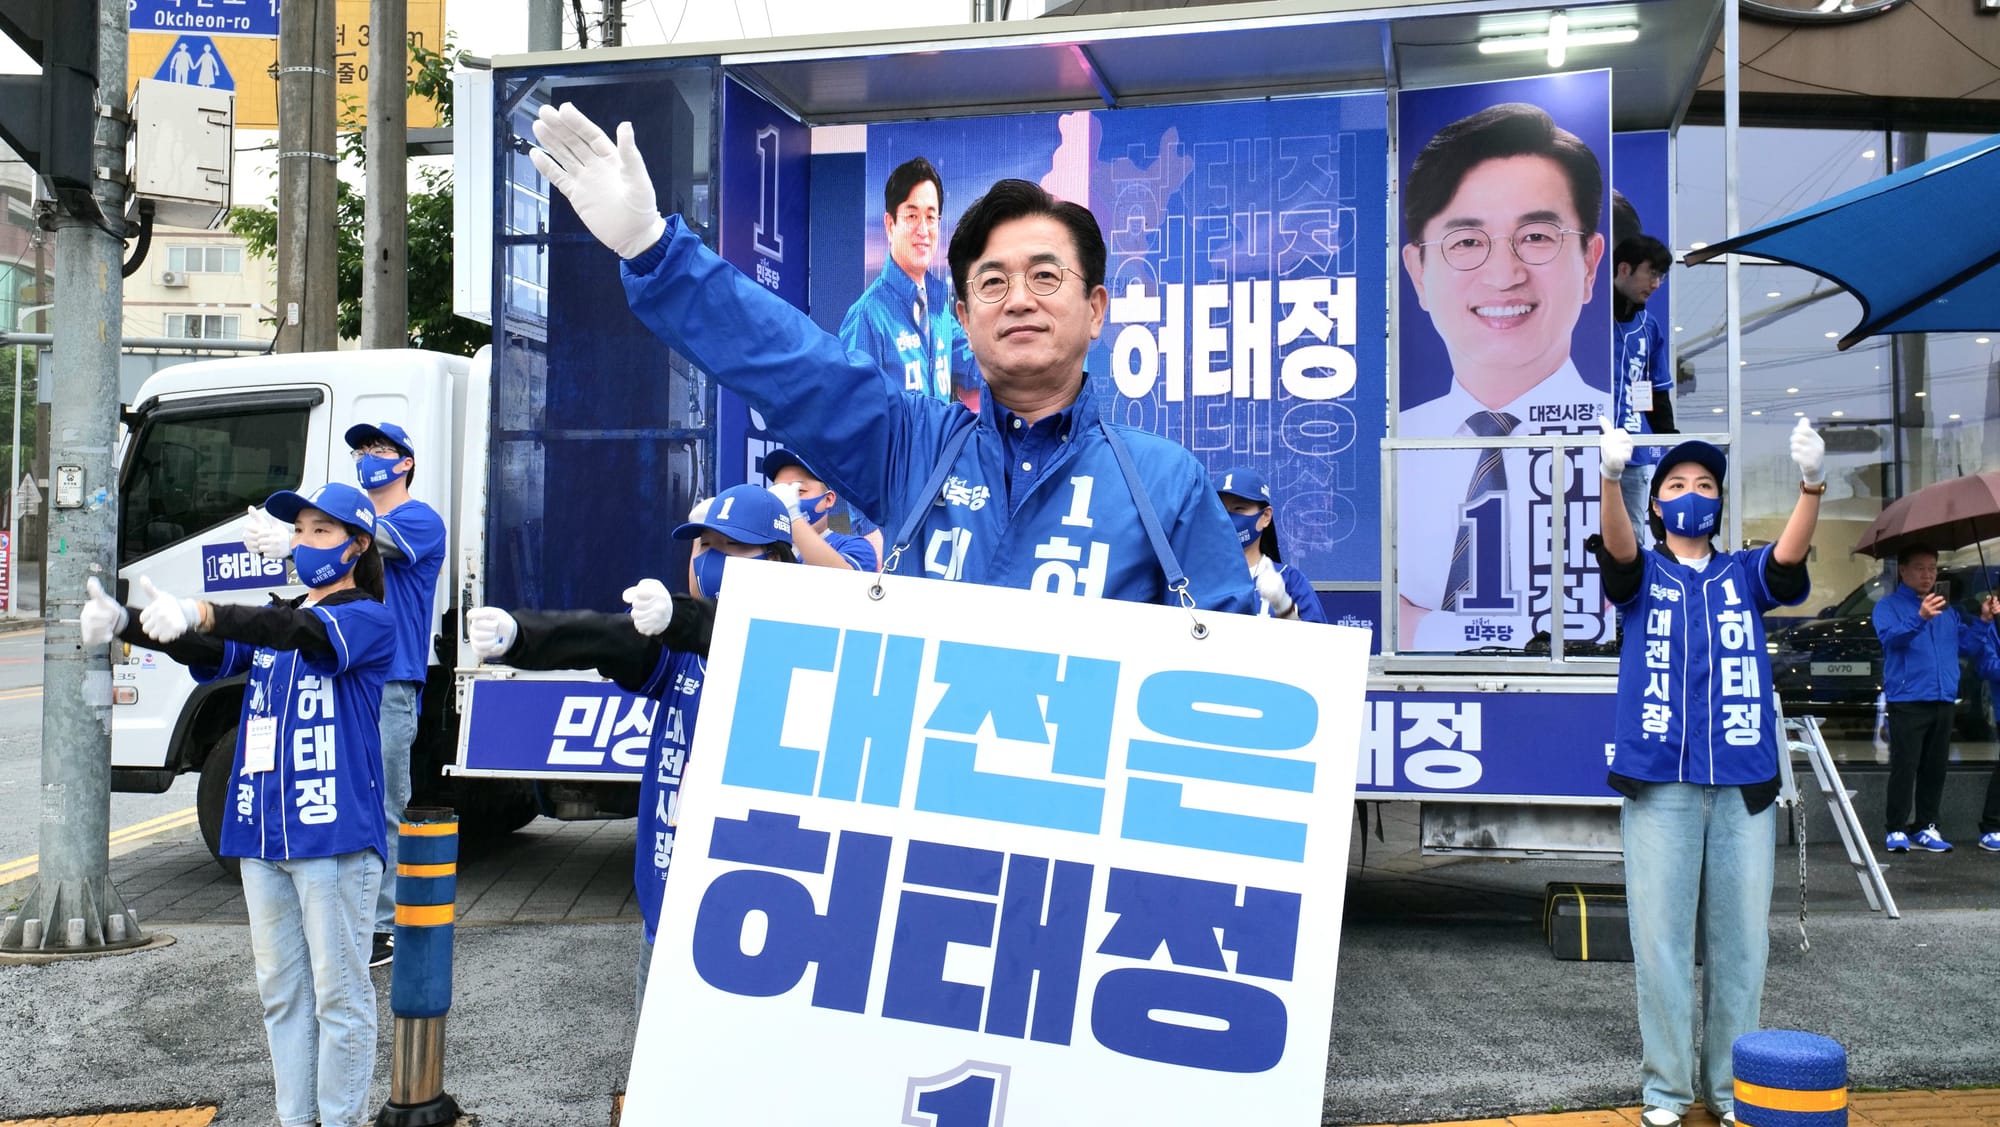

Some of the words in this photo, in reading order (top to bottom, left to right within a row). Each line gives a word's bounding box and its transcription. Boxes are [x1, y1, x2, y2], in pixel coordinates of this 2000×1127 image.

[154, 10, 250, 29] Okcheon-ro
[753, 124, 784, 264] 1
[756, 263, 780, 290] 민주당
[1109, 277, 1358, 402] 허태정
[1529, 403, 1594, 422] 대전시장
[716, 497, 735, 520] 1
[1061, 475, 1094, 528] 1
[1222, 474, 1233, 490] 1
[1676, 511, 1685, 530] 1
[207, 555, 219, 582] 1
[925, 527, 973, 580] 대
[1030, 536, 1110, 598] 허
[1456, 490, 1522, 616] 1
[1721, 578, 1741, 606] 1
[1464, 625, 1514, 642] 민주당
[1641, 608, 1672, 734] 대전시장
[1717, 609, 1762, 746] 허태정
[293, 675, 338, 825] 허태정
[721, 618, 1319, 863] 대전은
[692, 808, 1302, 1074] 허태정
